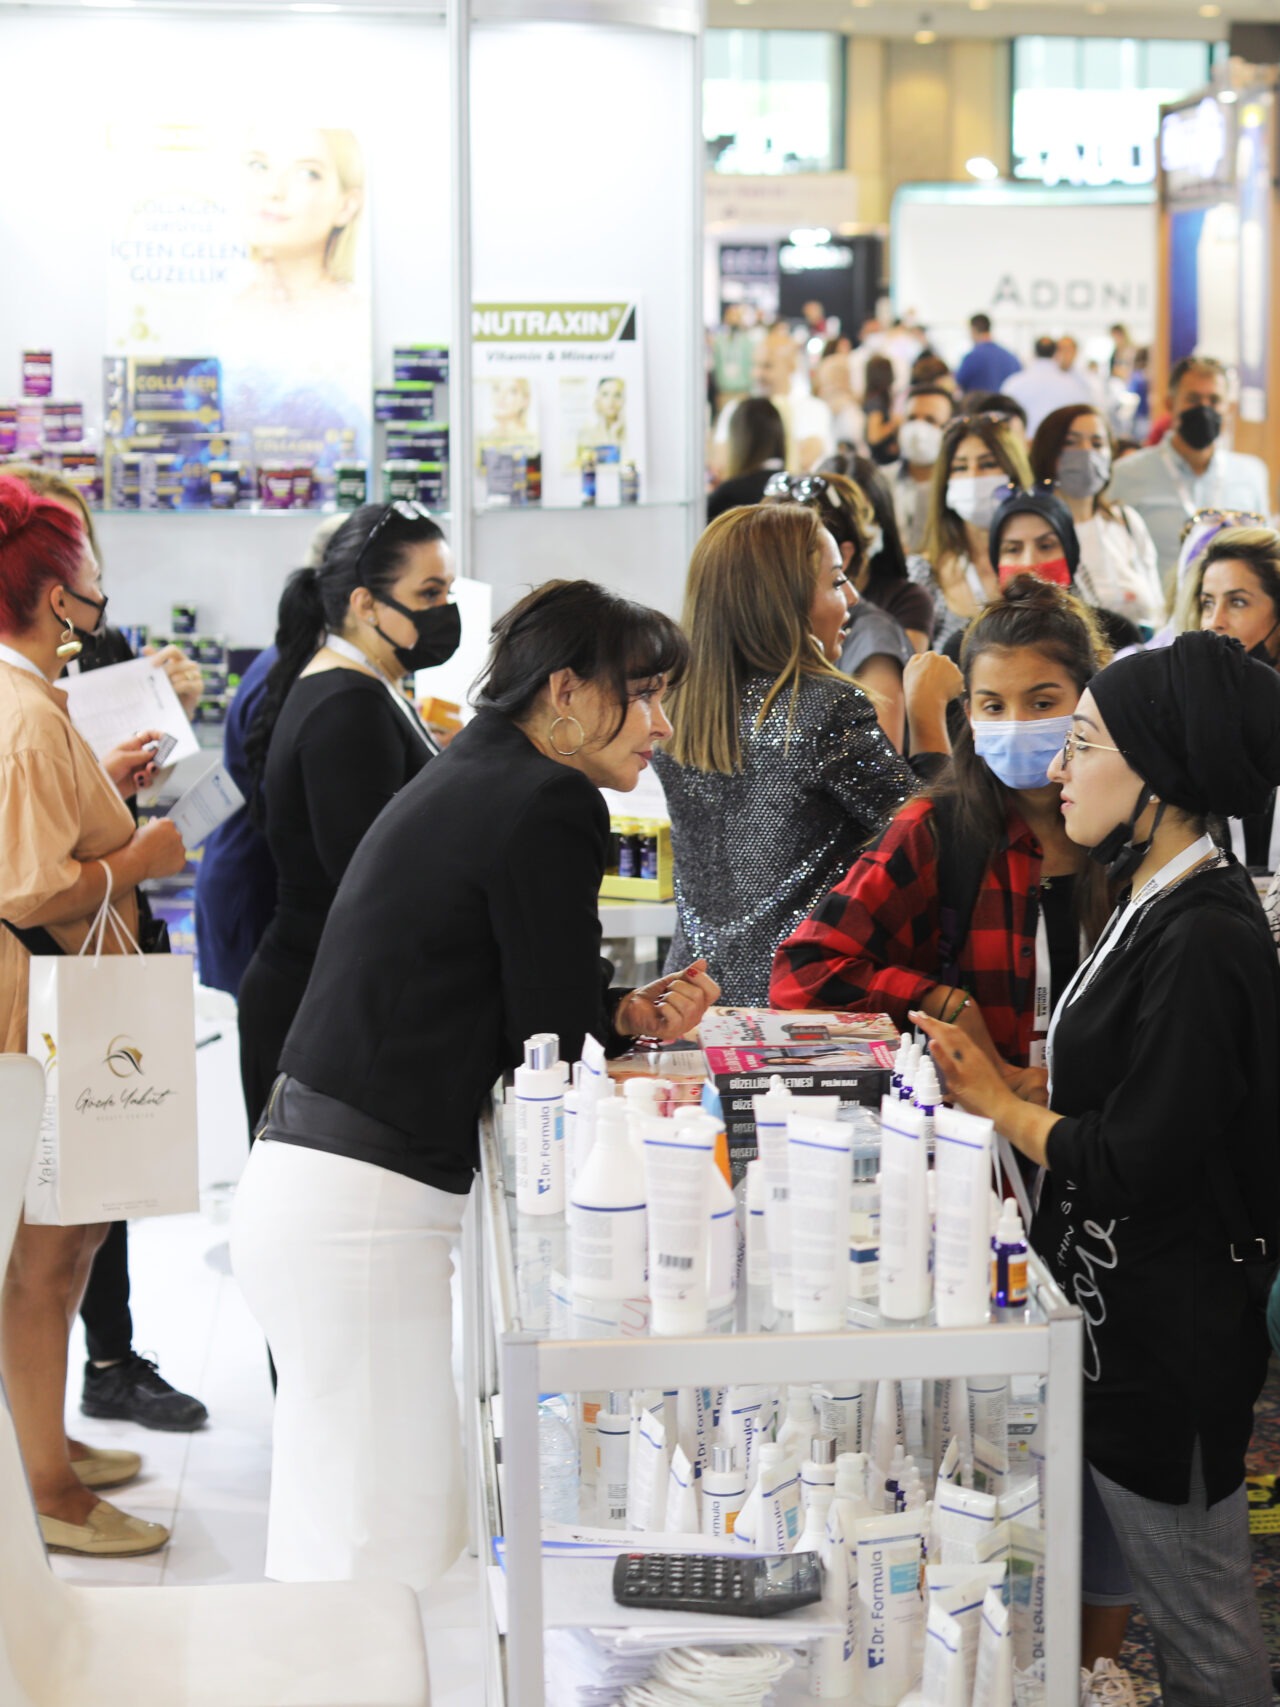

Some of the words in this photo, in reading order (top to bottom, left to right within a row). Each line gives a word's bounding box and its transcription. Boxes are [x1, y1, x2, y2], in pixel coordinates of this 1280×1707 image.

[180, 241, 248, 259] GELEN
[990, 272, 1149, 310] ADONI
[472, 310, 610, 336] NUTRAXIN
[540, 1105, 551, 1157] Formula
[872, 1550, 884, 1620] Formula
[872, 1623, 884, 1645] Dr.
